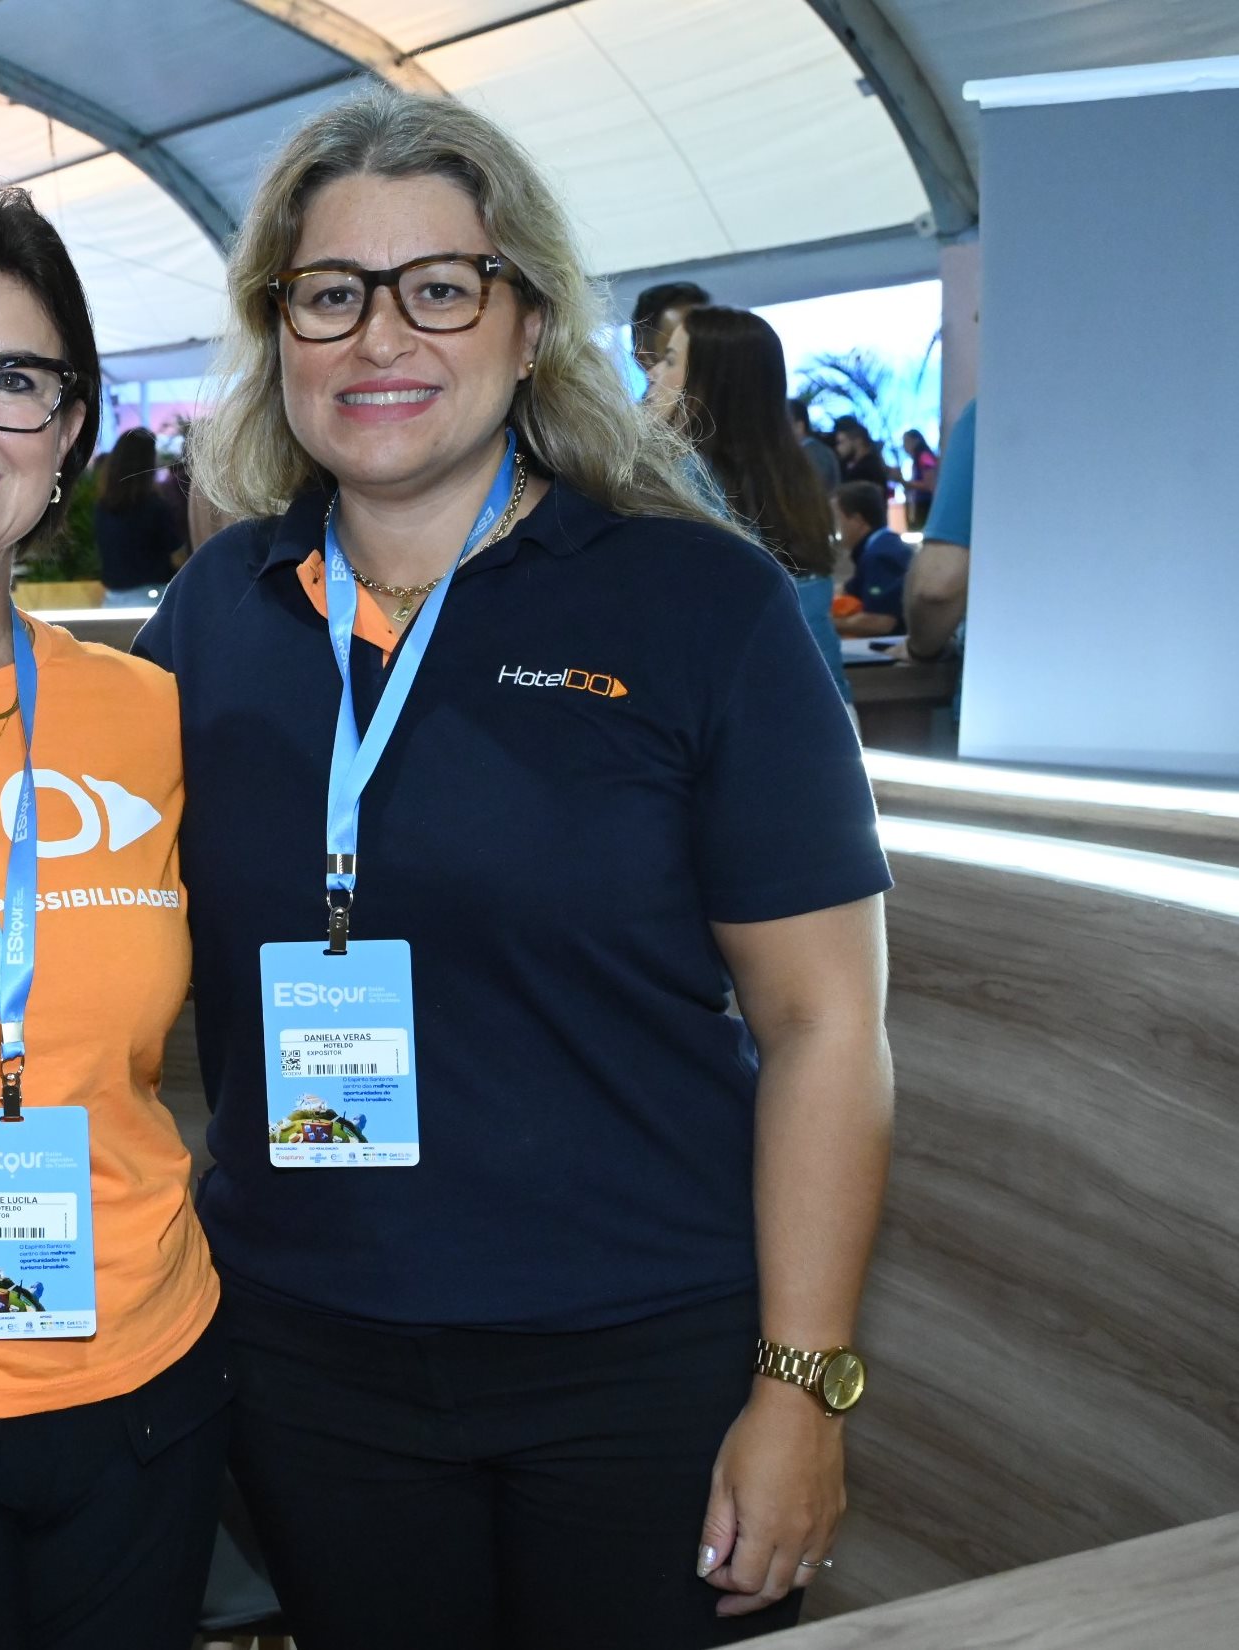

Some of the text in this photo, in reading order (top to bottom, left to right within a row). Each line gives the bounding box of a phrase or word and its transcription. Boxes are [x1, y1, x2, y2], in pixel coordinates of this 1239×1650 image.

[498, 665, 611, 696] HotelDO
[273, 982, 367, 1010] EStour
[304, 1033, 371, 1042] DANIELA VERAS
[7, 1196, 38, 1204] LUCILA
